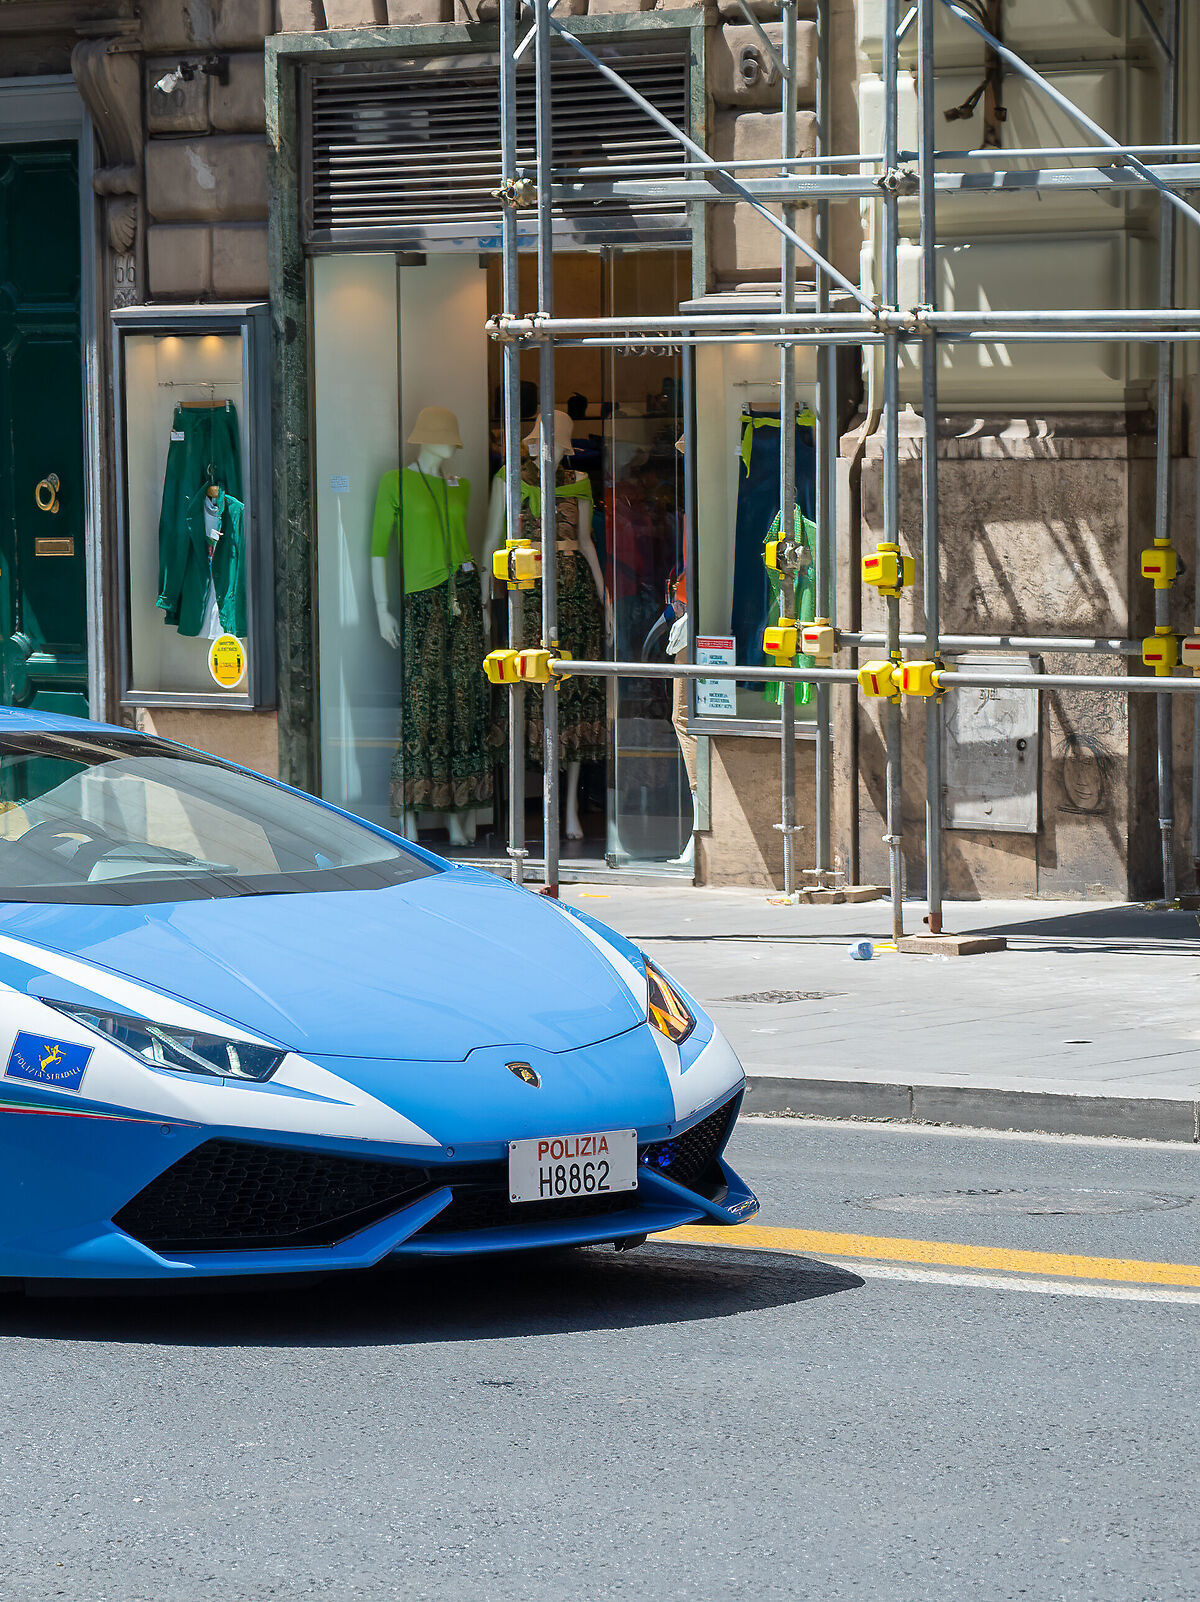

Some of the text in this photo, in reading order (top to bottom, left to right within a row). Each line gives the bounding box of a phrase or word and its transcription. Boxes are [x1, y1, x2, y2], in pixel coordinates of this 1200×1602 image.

[14, 1052, 43, 1078] POLIZIA
[538, 1136, 609, 1161] POLIZIA
[539, 1160, 610, 1197] H8862
